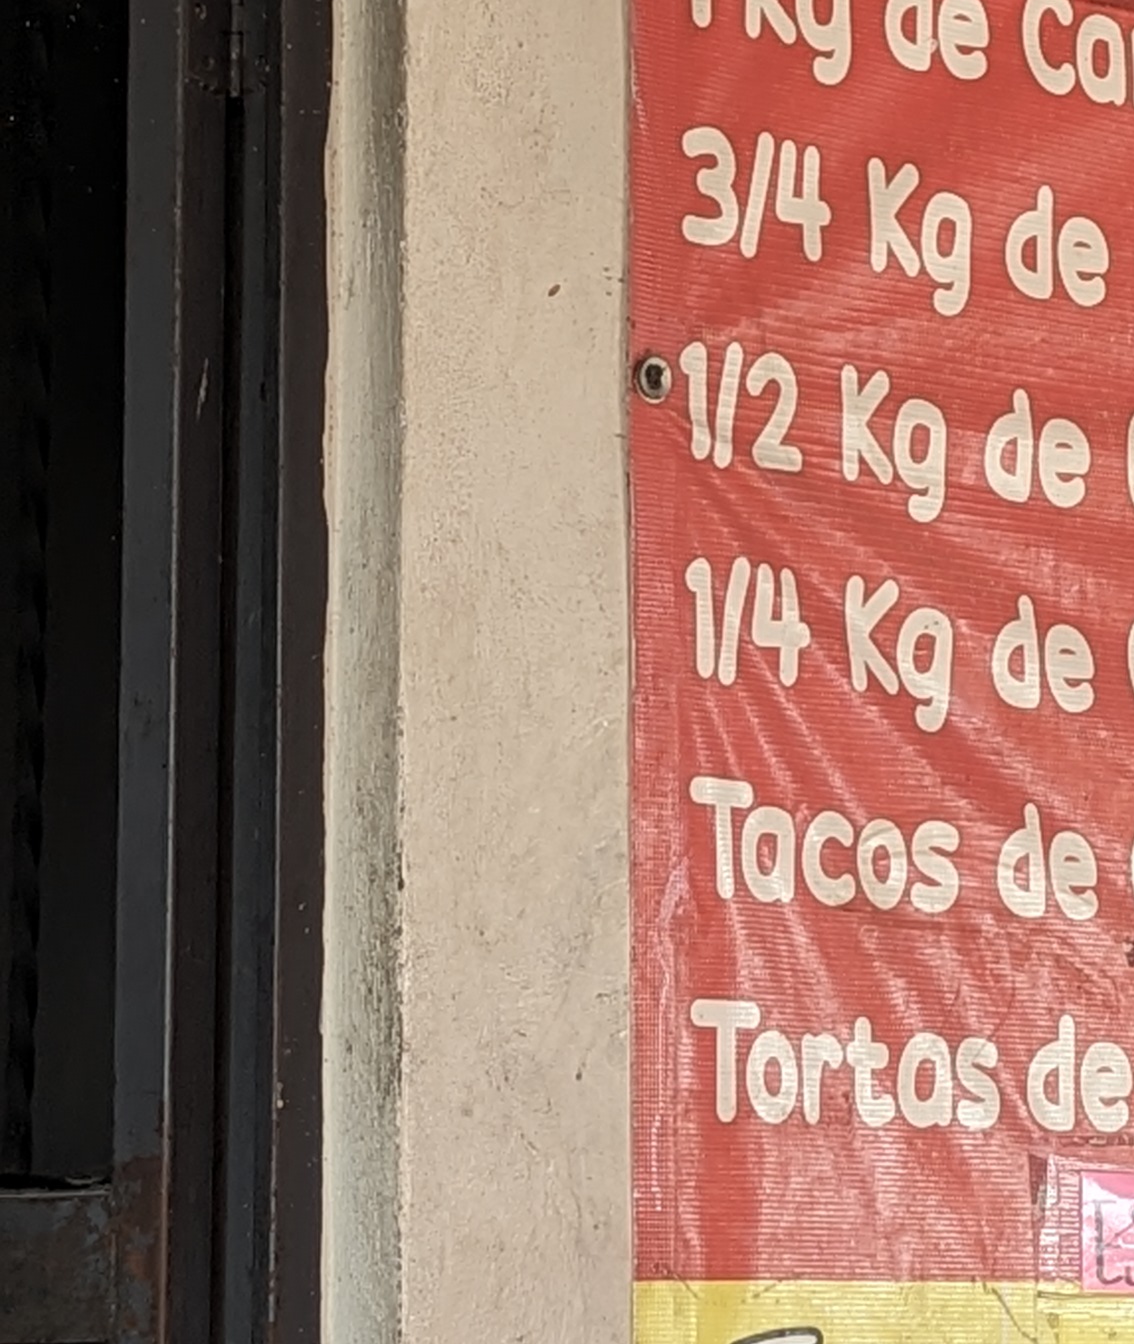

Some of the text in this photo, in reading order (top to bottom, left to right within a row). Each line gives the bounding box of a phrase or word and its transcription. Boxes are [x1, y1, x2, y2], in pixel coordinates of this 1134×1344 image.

[681, 125, 832, 263] 3/4
[867, 157, 972, 317] Kg
[1005, 184, 1110, 308] de
[680, 341, 803, 473] 1/2
[841, 363, 947, 523] Kg
[984, 387, 1091, 509] de
[685, 556, 811, 686] 1/4
[844, 574, 954, 732] Kg
[991, 594, 1096, 714] de
[689, 775, 961, 914] Tacos
[996, 801, 1100, 921] de
[690, 998, 1002, 1131] Tortas
[1026, 1014, 1133, 1134] de
